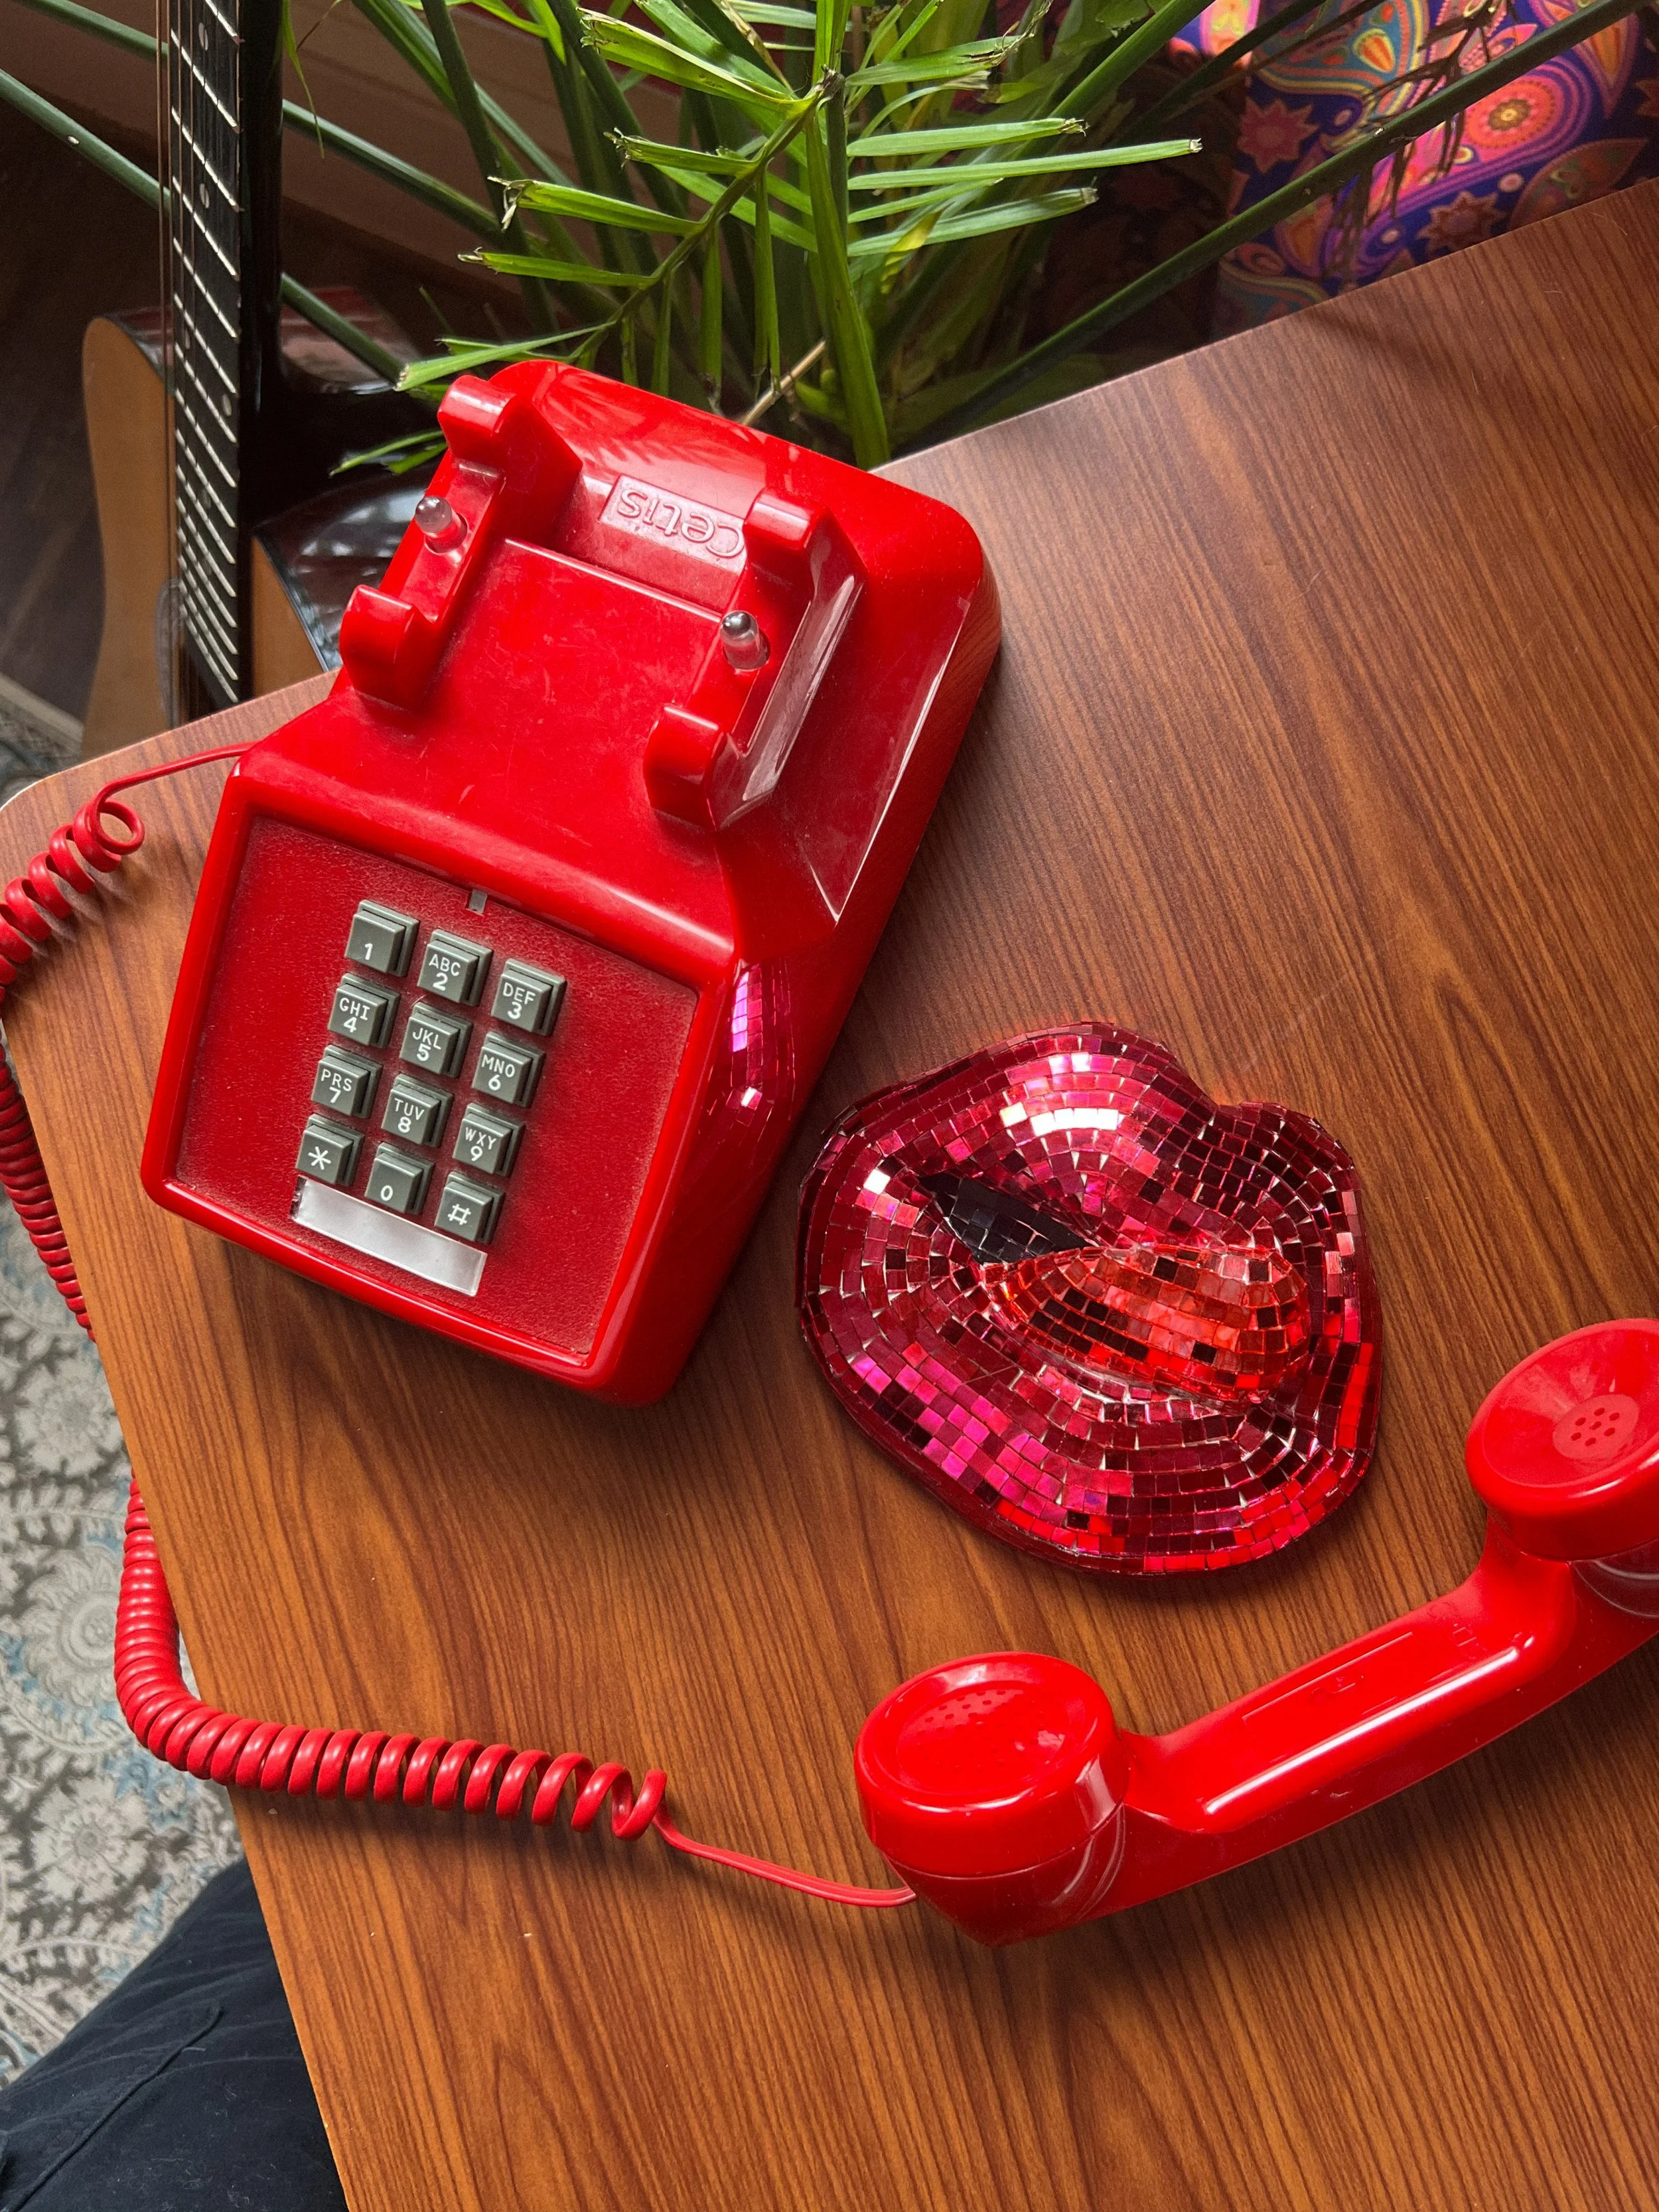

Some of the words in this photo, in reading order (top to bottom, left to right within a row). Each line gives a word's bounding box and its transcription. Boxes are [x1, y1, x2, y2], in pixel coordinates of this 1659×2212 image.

[364, 942, 374, 960] 1
[428, 954, 461, 977] ABC
[431, 971, 449, 992] 2
[502, 982, 537, 1005] DEF
[339, 997, 369, 1021] GHI
[506, 1000, 523, 1020] 3
[342, 1015, 358, 1034] 4
[411, 1028, 443, 1051] JKL
[415, 1042, 432, 1062] 5
[481, 1054, 516, 1079] MNO
[320, 1068, 354, 1092] PRS
[488, 1073, 502, 1091] 6
[329, 1086, 342, 1104] 7
[394, 1097, 425, 1120] TUV
[397, 1116, 413, 1134] 8
[465, 1126, 498, 1150] WXY
[470, 1145, 484, 1163] 9
[447, 1203, 472, 1226] #
